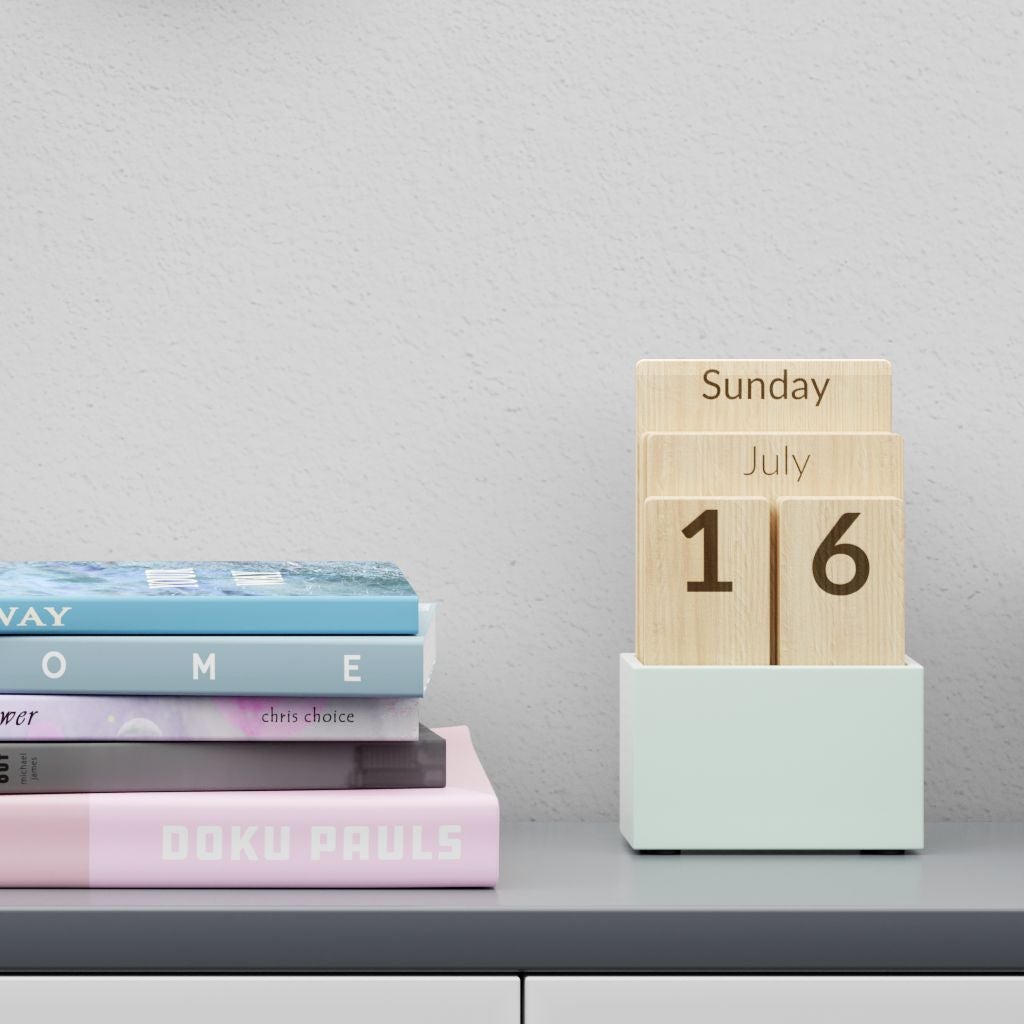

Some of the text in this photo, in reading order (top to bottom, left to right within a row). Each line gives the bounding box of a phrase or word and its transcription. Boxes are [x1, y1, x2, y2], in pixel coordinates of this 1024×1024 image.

[702, 368, 830, 406] Sunday
[743, 445, 811, 482] July
[261, 706, 355, 723] chris choice
[19, 753, 28, 785] michael
[30, 757, 40, 781] james
[162, 824, 463, 861] DOKU PAULS
